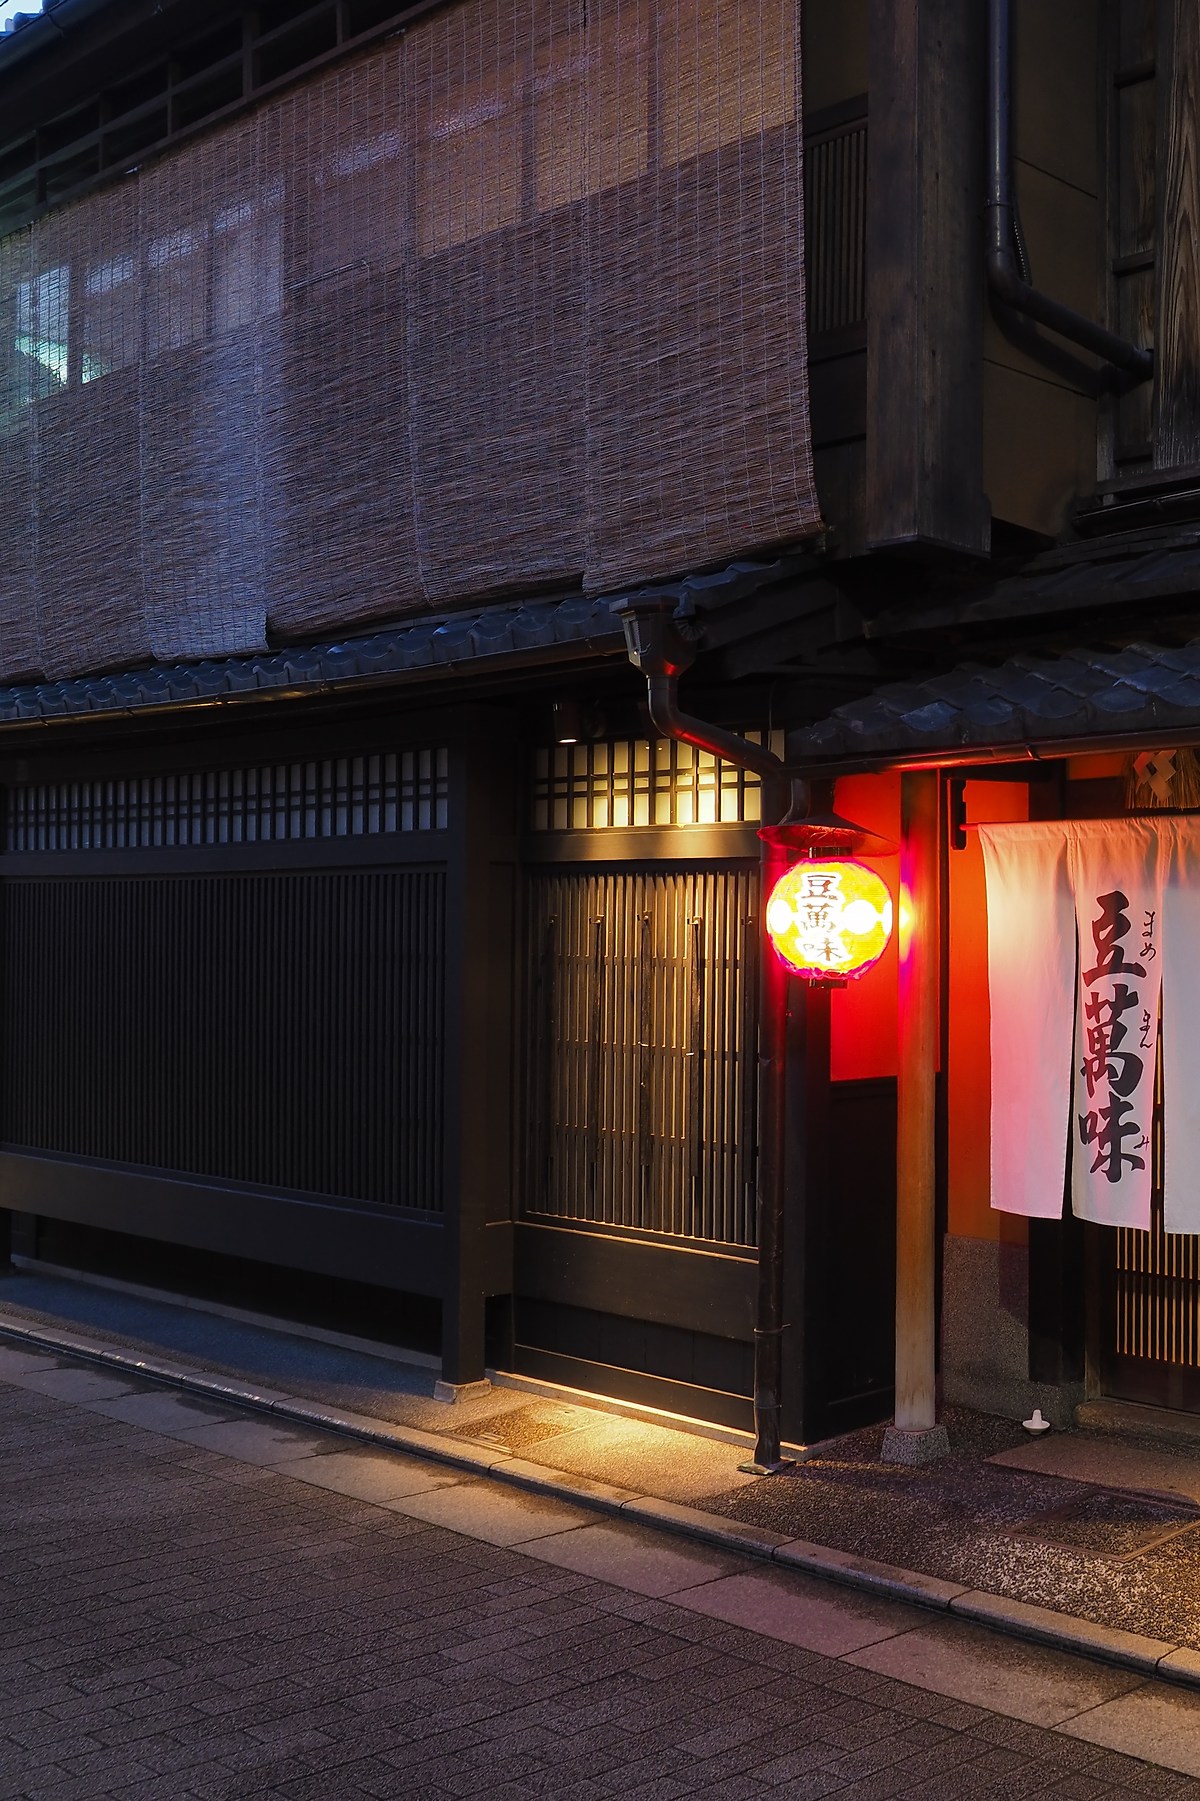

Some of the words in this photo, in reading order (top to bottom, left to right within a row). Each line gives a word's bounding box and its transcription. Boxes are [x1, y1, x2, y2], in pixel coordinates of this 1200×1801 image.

[801, 874, 843, 961] 豆萬味
[1139, 911, 1157, 961] まめ
[1078, 890, 1147, 1183] 豆萬味
[1138, 1010, 1154, 1049] まん
[1133, 1135, 1150, 1151] み
